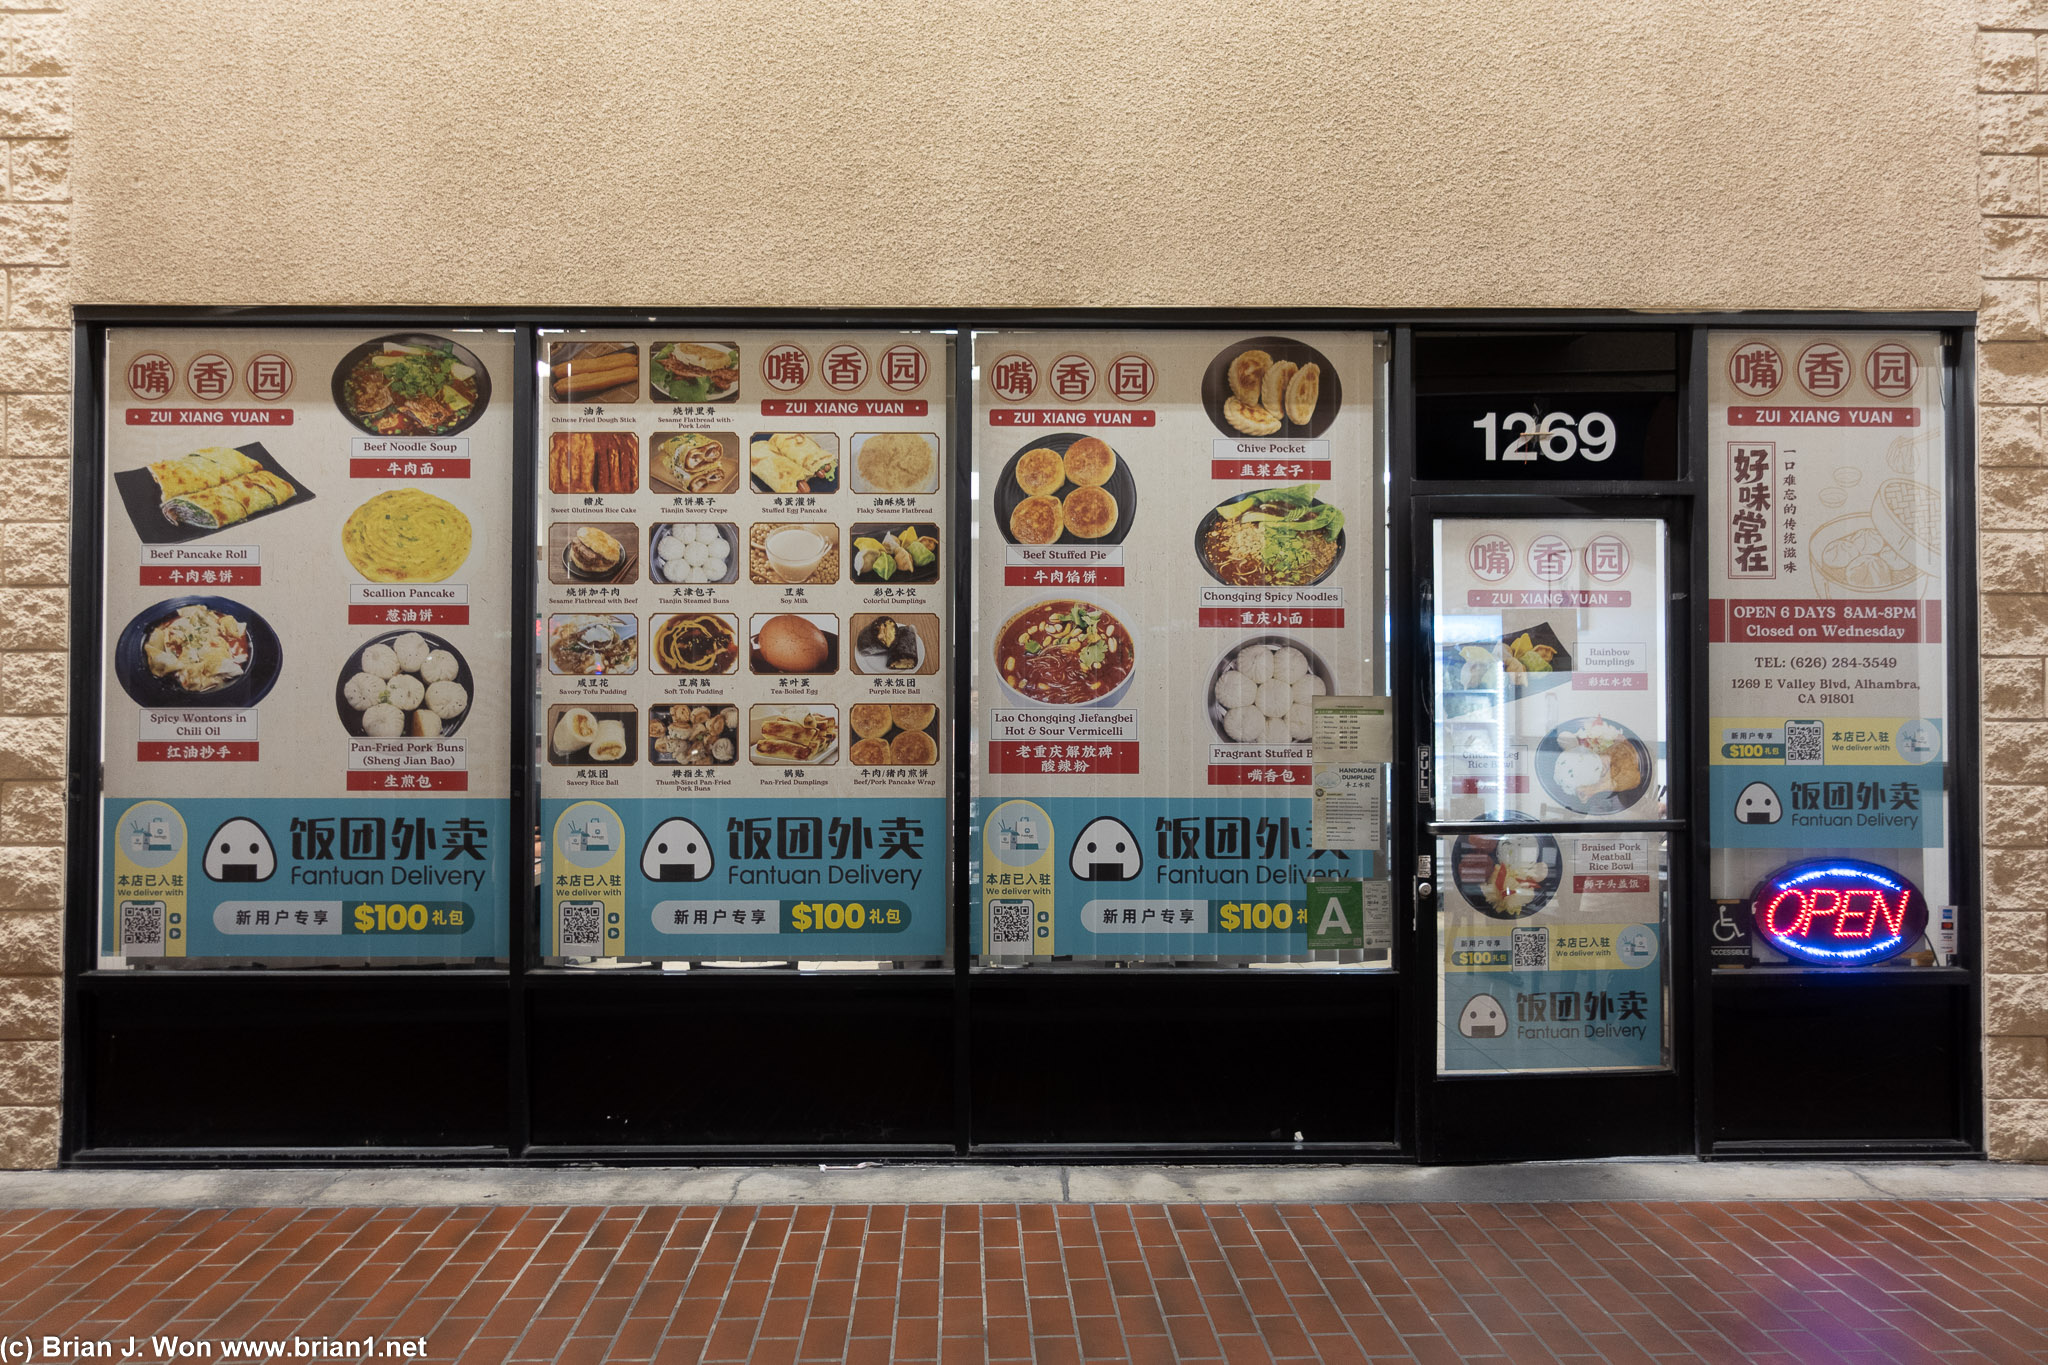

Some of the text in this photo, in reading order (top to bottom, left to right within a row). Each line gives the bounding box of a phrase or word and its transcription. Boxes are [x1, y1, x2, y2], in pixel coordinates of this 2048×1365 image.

[768, 352, 919, 384] 嘴香园
[1735, 351, 1911, 389] 嘴香园
[133, 361, 286, 394] 嘴香园
[997, 362, 1147, 395] 嘴香园
[786, 403, 903, 413] ZUI XIANG YUAN
[151, 412, 269, 423] ZUI XIANG YUAN
[1014, 413, 1132, 424] ZUI XIANG YUAN
[1756, 411, 1892, 423] ZUI XIANG YUAN
[1473, 412, 1616, 461] 1269
[364, 442, 457, 453] Beef Noodle Soup
[1237, 444, 1305, 453] Chive Pocket
[387, 462, 434, 476] 牛肉面
[1240, 464, 1303, 477] 韭菜盒子
[1733, 449, 1770, 572] 好味常在
[1783, 450, 1797, 573] 一口难忘的传统滋味
[150, 550, 247, 559] Beef Pancake Roll
[1023, 551, 1106, 559] Beef Stuffed Pie
[1474, 541, 1622, 574] 嘴香园
[169, 570, 233, 583] 牛肉卷饼
[1034, 570, 1096, 584] 牛肉馅饼
[363, 589, 455, 598] Scallion Pancake
[874, 588, 916, 596] 彩色水饺
[1204, 592, 1338, 602] Chongqing Spicy Noodles
[1492, 594, 1608, 604] ZUI XIANG YUAN
[386, 609, 433, 622] 葱油饼
[1240, 612, 1302, 625] 重庆小面
[1734, 607, 1916, 618] OPEN 6 DAYS 8AM~8PM
[1747, 625, 1905, 639] Closed on Wednesday
[1590, 648, 1630, 656] Rainbow
[1585, 658, 1634, 666] Dumplings
[1755, 657, 1897, 669] TEL: (626) 284-3549
[874, 679, 915, 687] 紫米饭团
[1731, 679, 1920, 690] 1269 E Valley Blvd, Alhambra,
[1798, 694, 1854, 704] CA 91801
[150, 713, 246, 724] Spicy Wontons in
[995, 714, 1133, 724] Lao Chongqing Jiefangbei
[176, 726, 220, 736] Chili Oil
[1005, 727, 1025, 735] Hot
[1040, 727, 1064, 735] Sour
[1068, 727, 1123, 735] Vermicelli
[1832, 732, 1889, 742] 本店已入驻
[167, 745, 230, 759] 红油抄手
[351, 743, 464, 752] Pan-Fried Pork Buns
[1016, 745, 1113, 758] 老重庆解放碑
[1214, 749, 1262, 759] Fragrant
[1265, 749, 1302, 757] Stuffed
[363, 756, 455, 766] (Sheng Jian Bao)
[1042, 760, 1089, 772] 酸辣粉
[384, 775, 432, 788] 生煎包
[1248, 769, 1295, 782] 嘴香包
[1791, 782, 1919, 810] 饭团外卖
[1792, 814, 1918, 829] Fantuan Delivery
[290, 818, 487, 860] 饭团外卖
[727, 818, 924, 860] 饭团外卖
[118, 875, 184, 886] 本店已入驻
[291, 866, 485, 891] Fantuan Delivery
[729, 865, 922, 890] Fantuan Delivery
[1157, 865, 1249, 884] Fantuan
[236, 910, 328, 925] 新用户专享
[354, 903, 464, 933] $100 礼包
[674, 909, 766, 925] 新用户专享
[792, 902, 900, 932] $100 礼包
[1103, 909, 1194, 924] 新用户专享
[1220, 902, 1291, 932] $100
[1317, 897, 1352, 934] A
[1766, 888, 1911, 938] OPEN
[1517, 992, 1648, 1022] 饭团外卖
[1518, 1024, 1646, 1040] Fantuan Delivery
